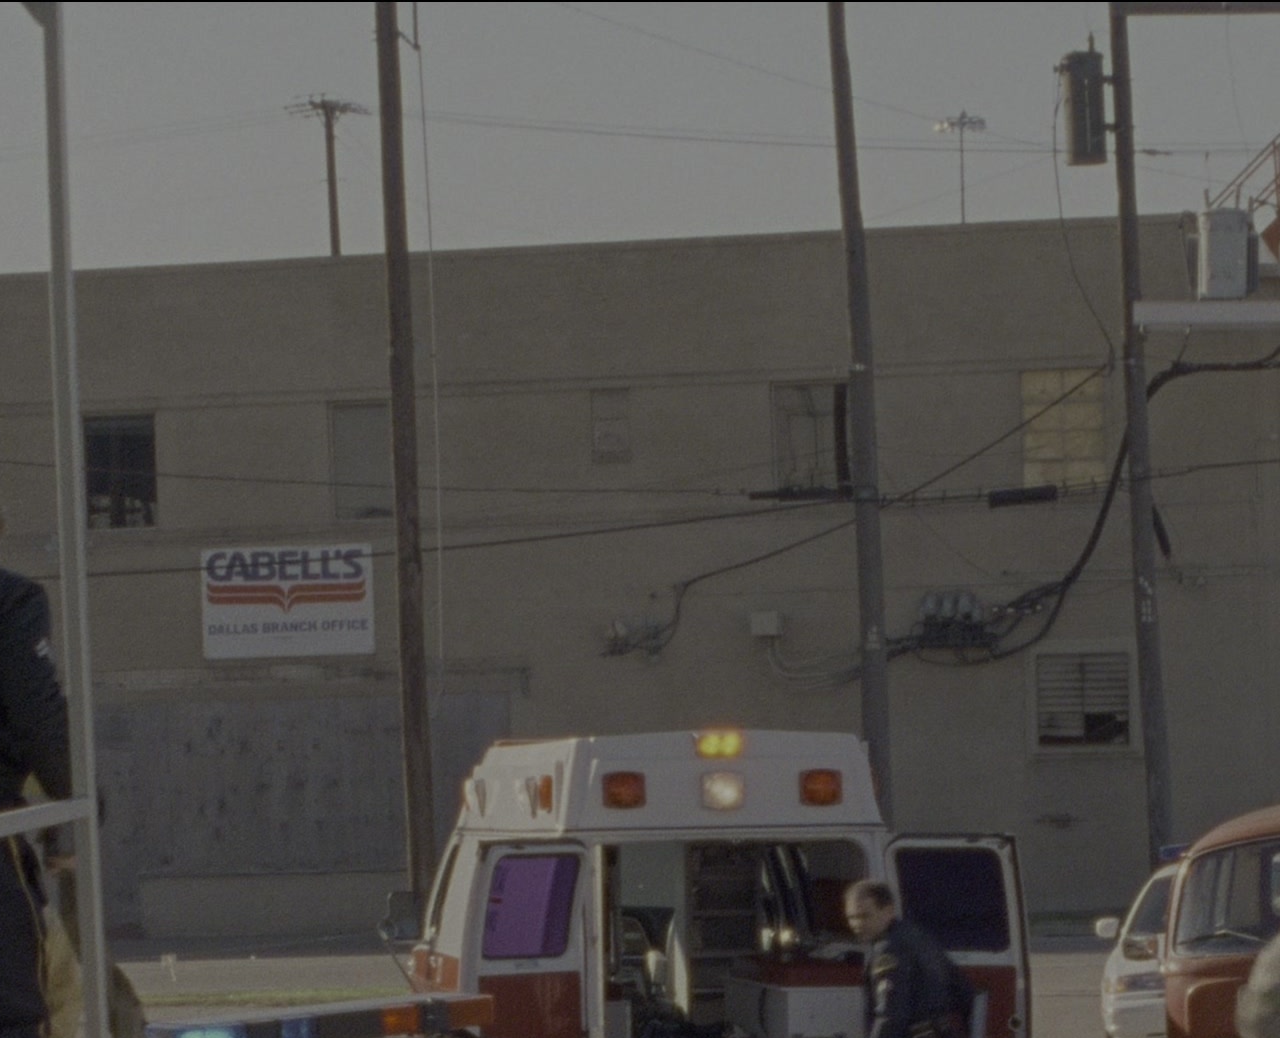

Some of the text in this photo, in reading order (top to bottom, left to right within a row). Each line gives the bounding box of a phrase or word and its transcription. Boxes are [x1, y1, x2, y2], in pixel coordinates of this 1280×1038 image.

[207, 549, 363, 582] CABELL'S
[208, 617, 369, 636] DALLAS BRANCH OFFICE
